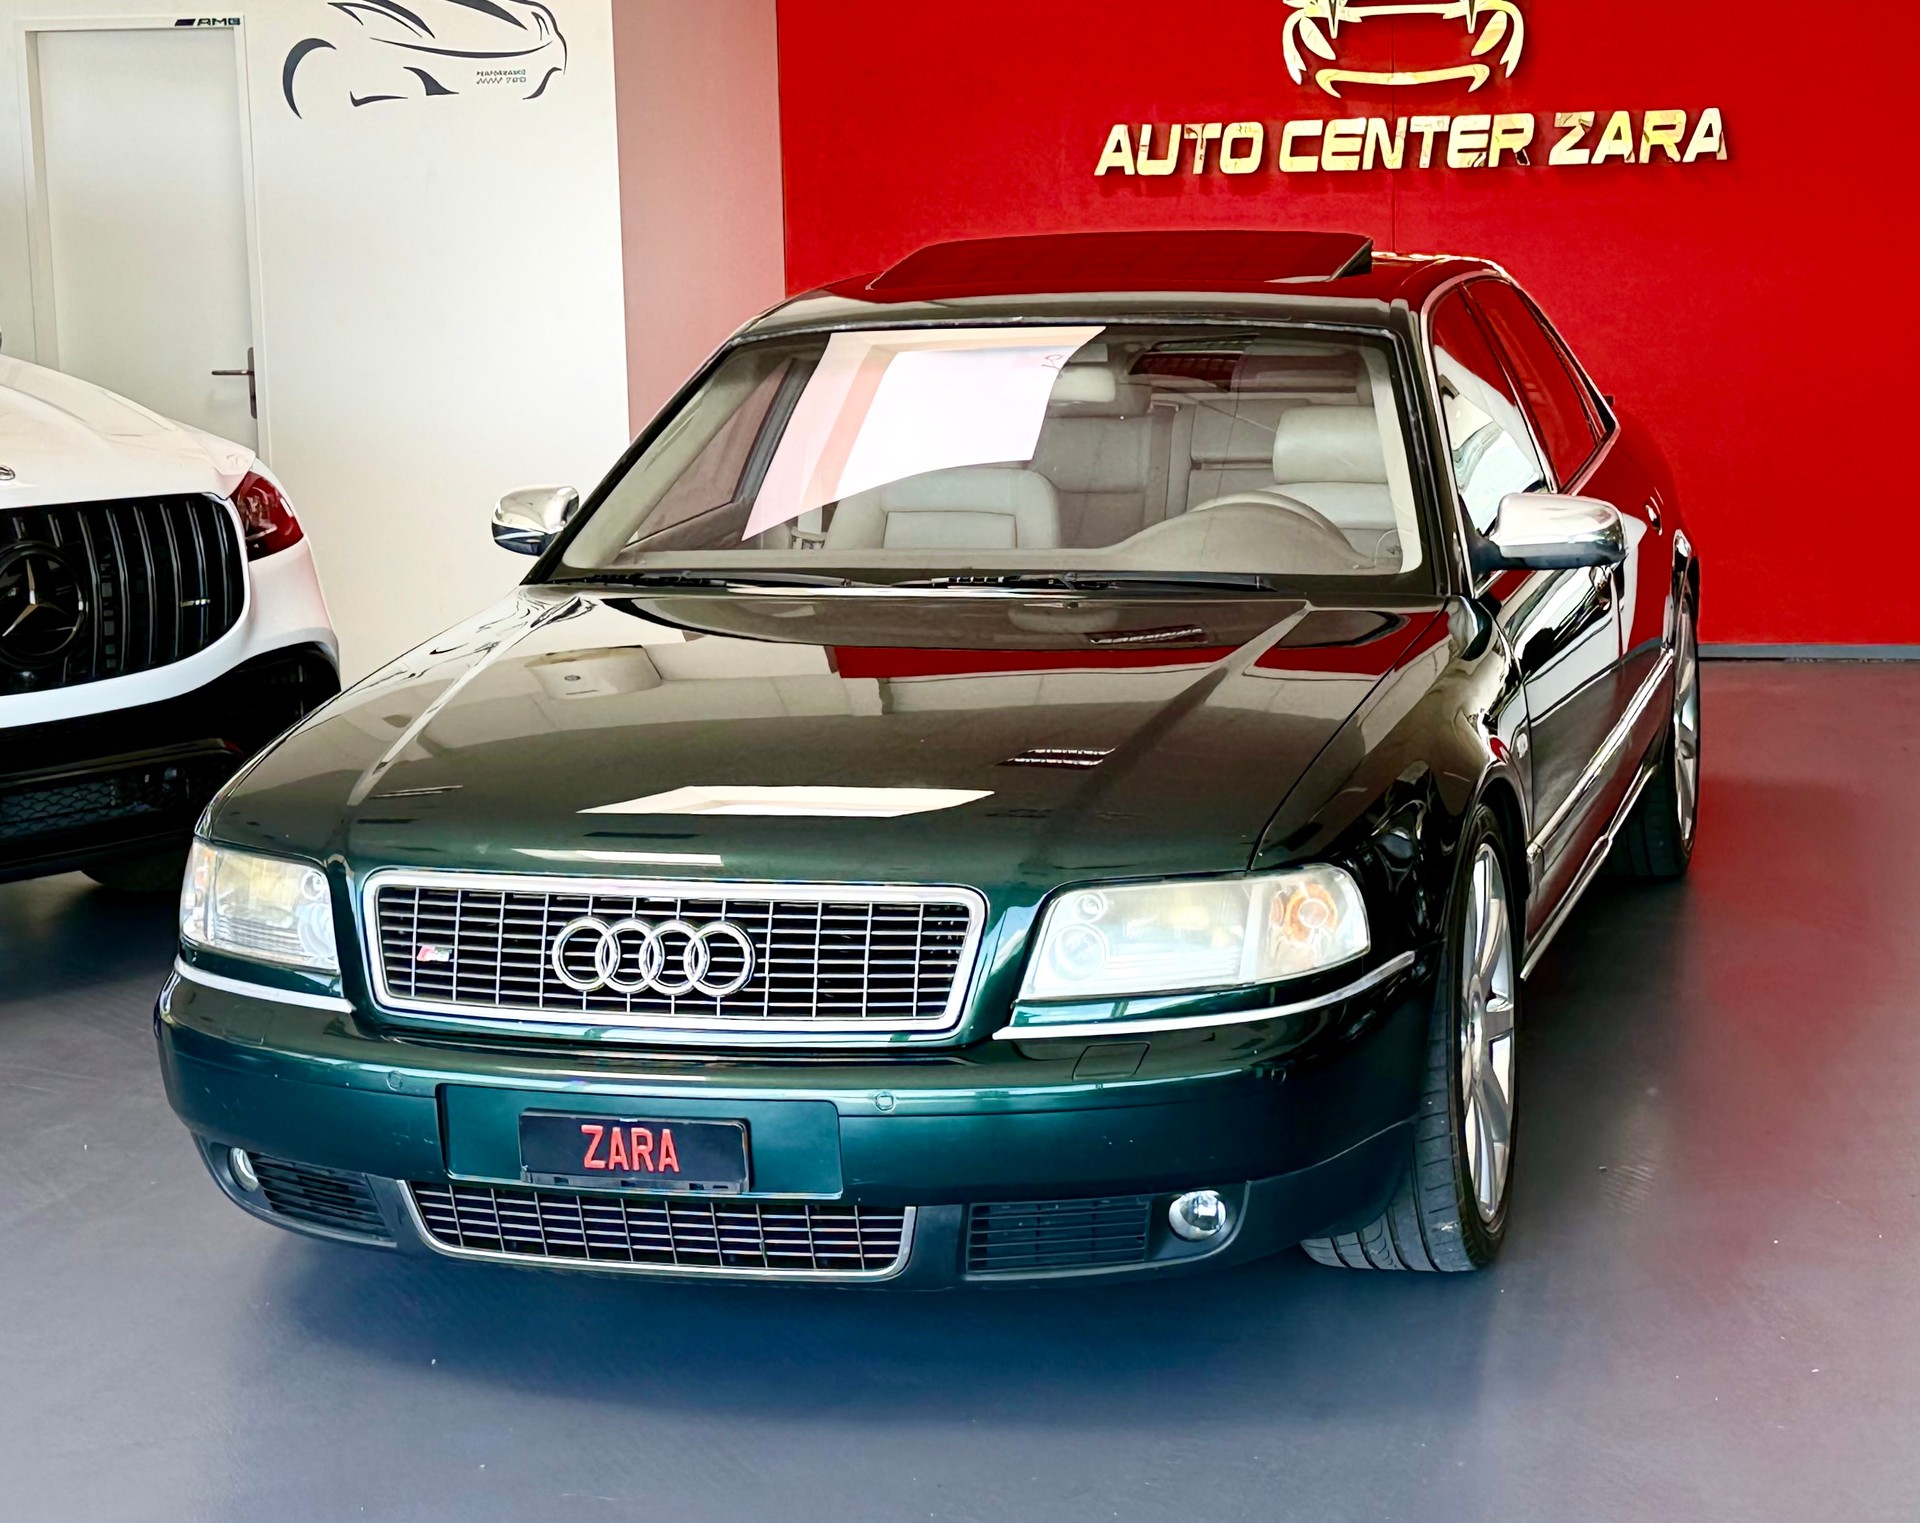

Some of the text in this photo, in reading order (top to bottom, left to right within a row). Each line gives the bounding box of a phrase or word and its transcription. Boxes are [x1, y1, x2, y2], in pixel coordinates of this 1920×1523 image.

[1094, 107, 1728, 176] AUTO CENTER ZARA
[580, 1123, 681, 1174] ZARA
